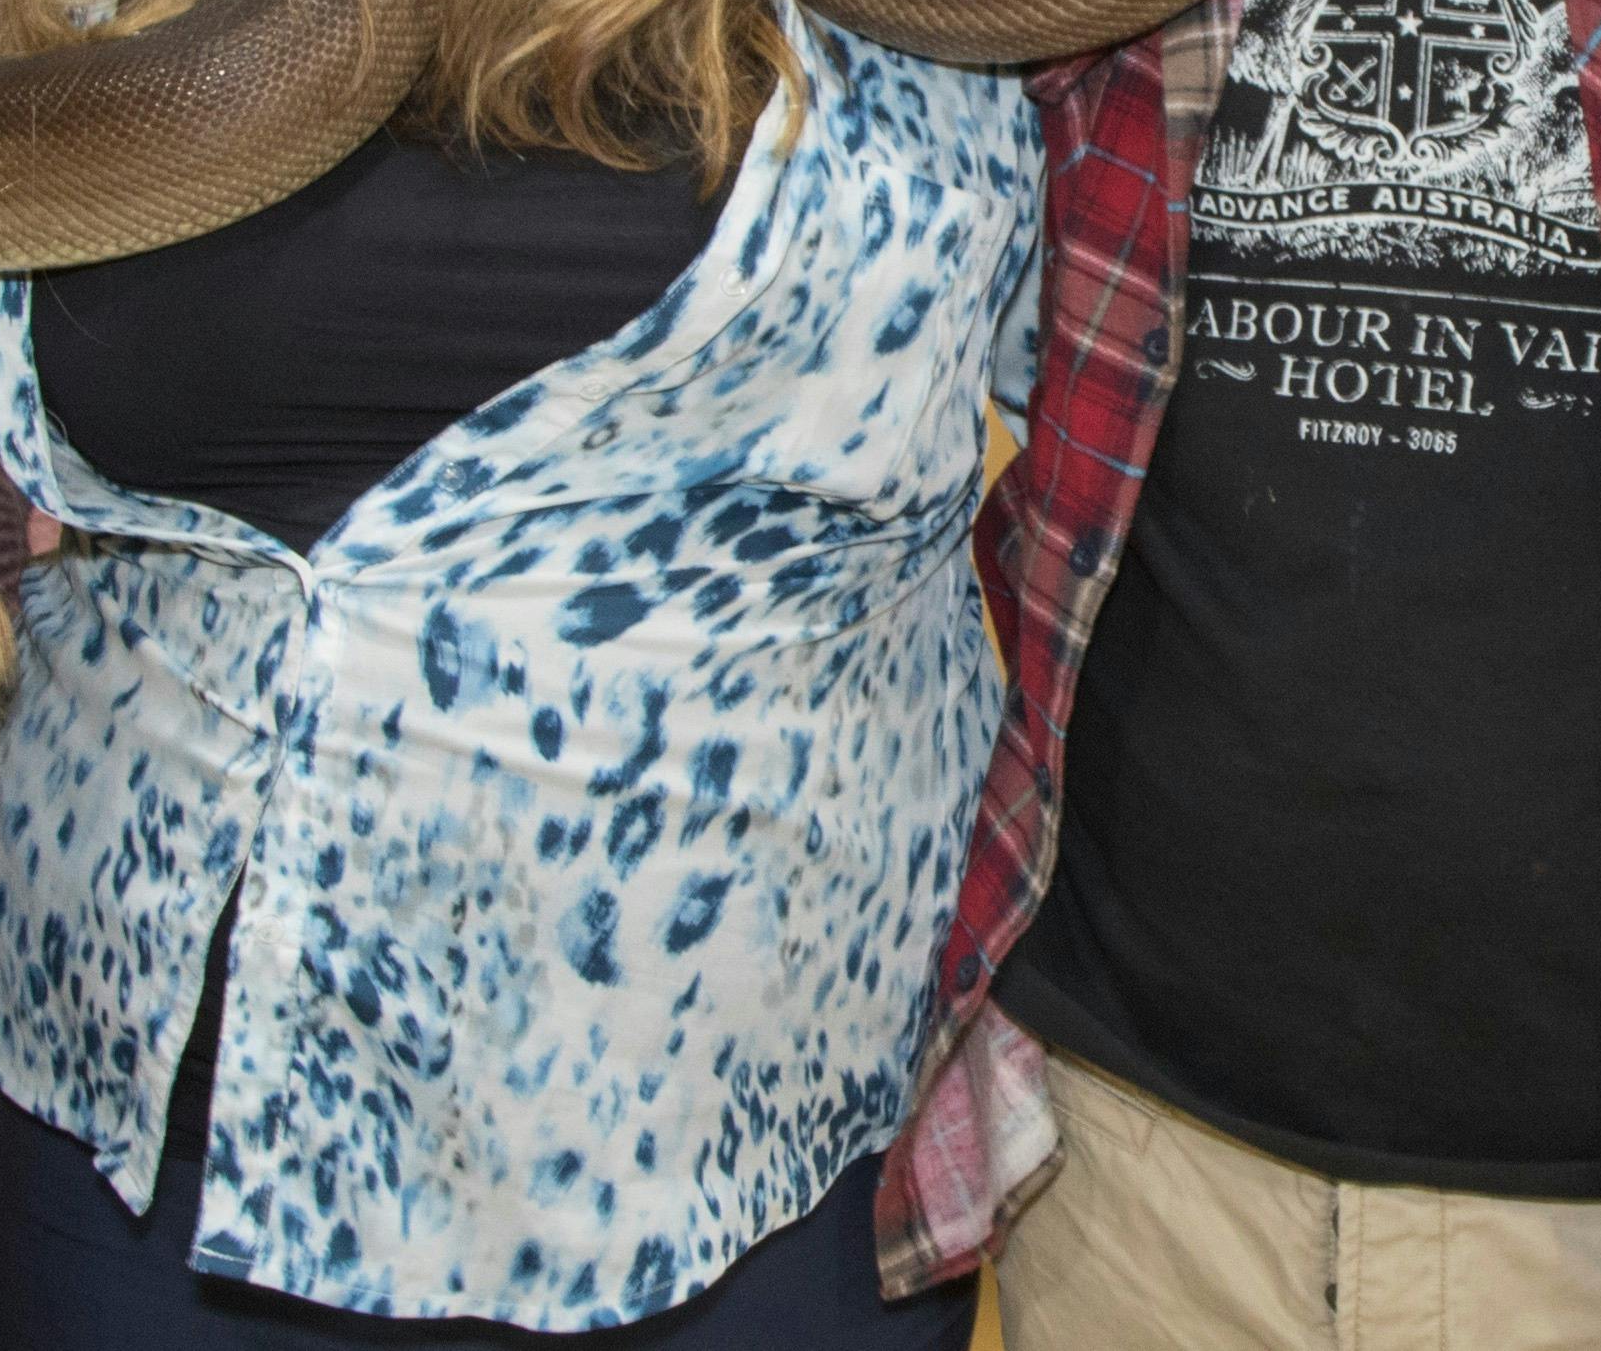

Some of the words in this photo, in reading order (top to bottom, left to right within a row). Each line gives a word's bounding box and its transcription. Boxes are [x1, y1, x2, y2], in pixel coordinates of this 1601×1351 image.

[1199, 186, 1351, 221] ADVANCE
[1372, 186, 1587, 256] AUSTRALIA.
[1186, 298, 1392, 352] ABOUR
[1409, 312, 1483, 362] IN
[1273, 352, 1495, 417] HOTEL
[1299, 417, 1383, 447] FITZROY
[1406, 425, 1459, 455] 3065
